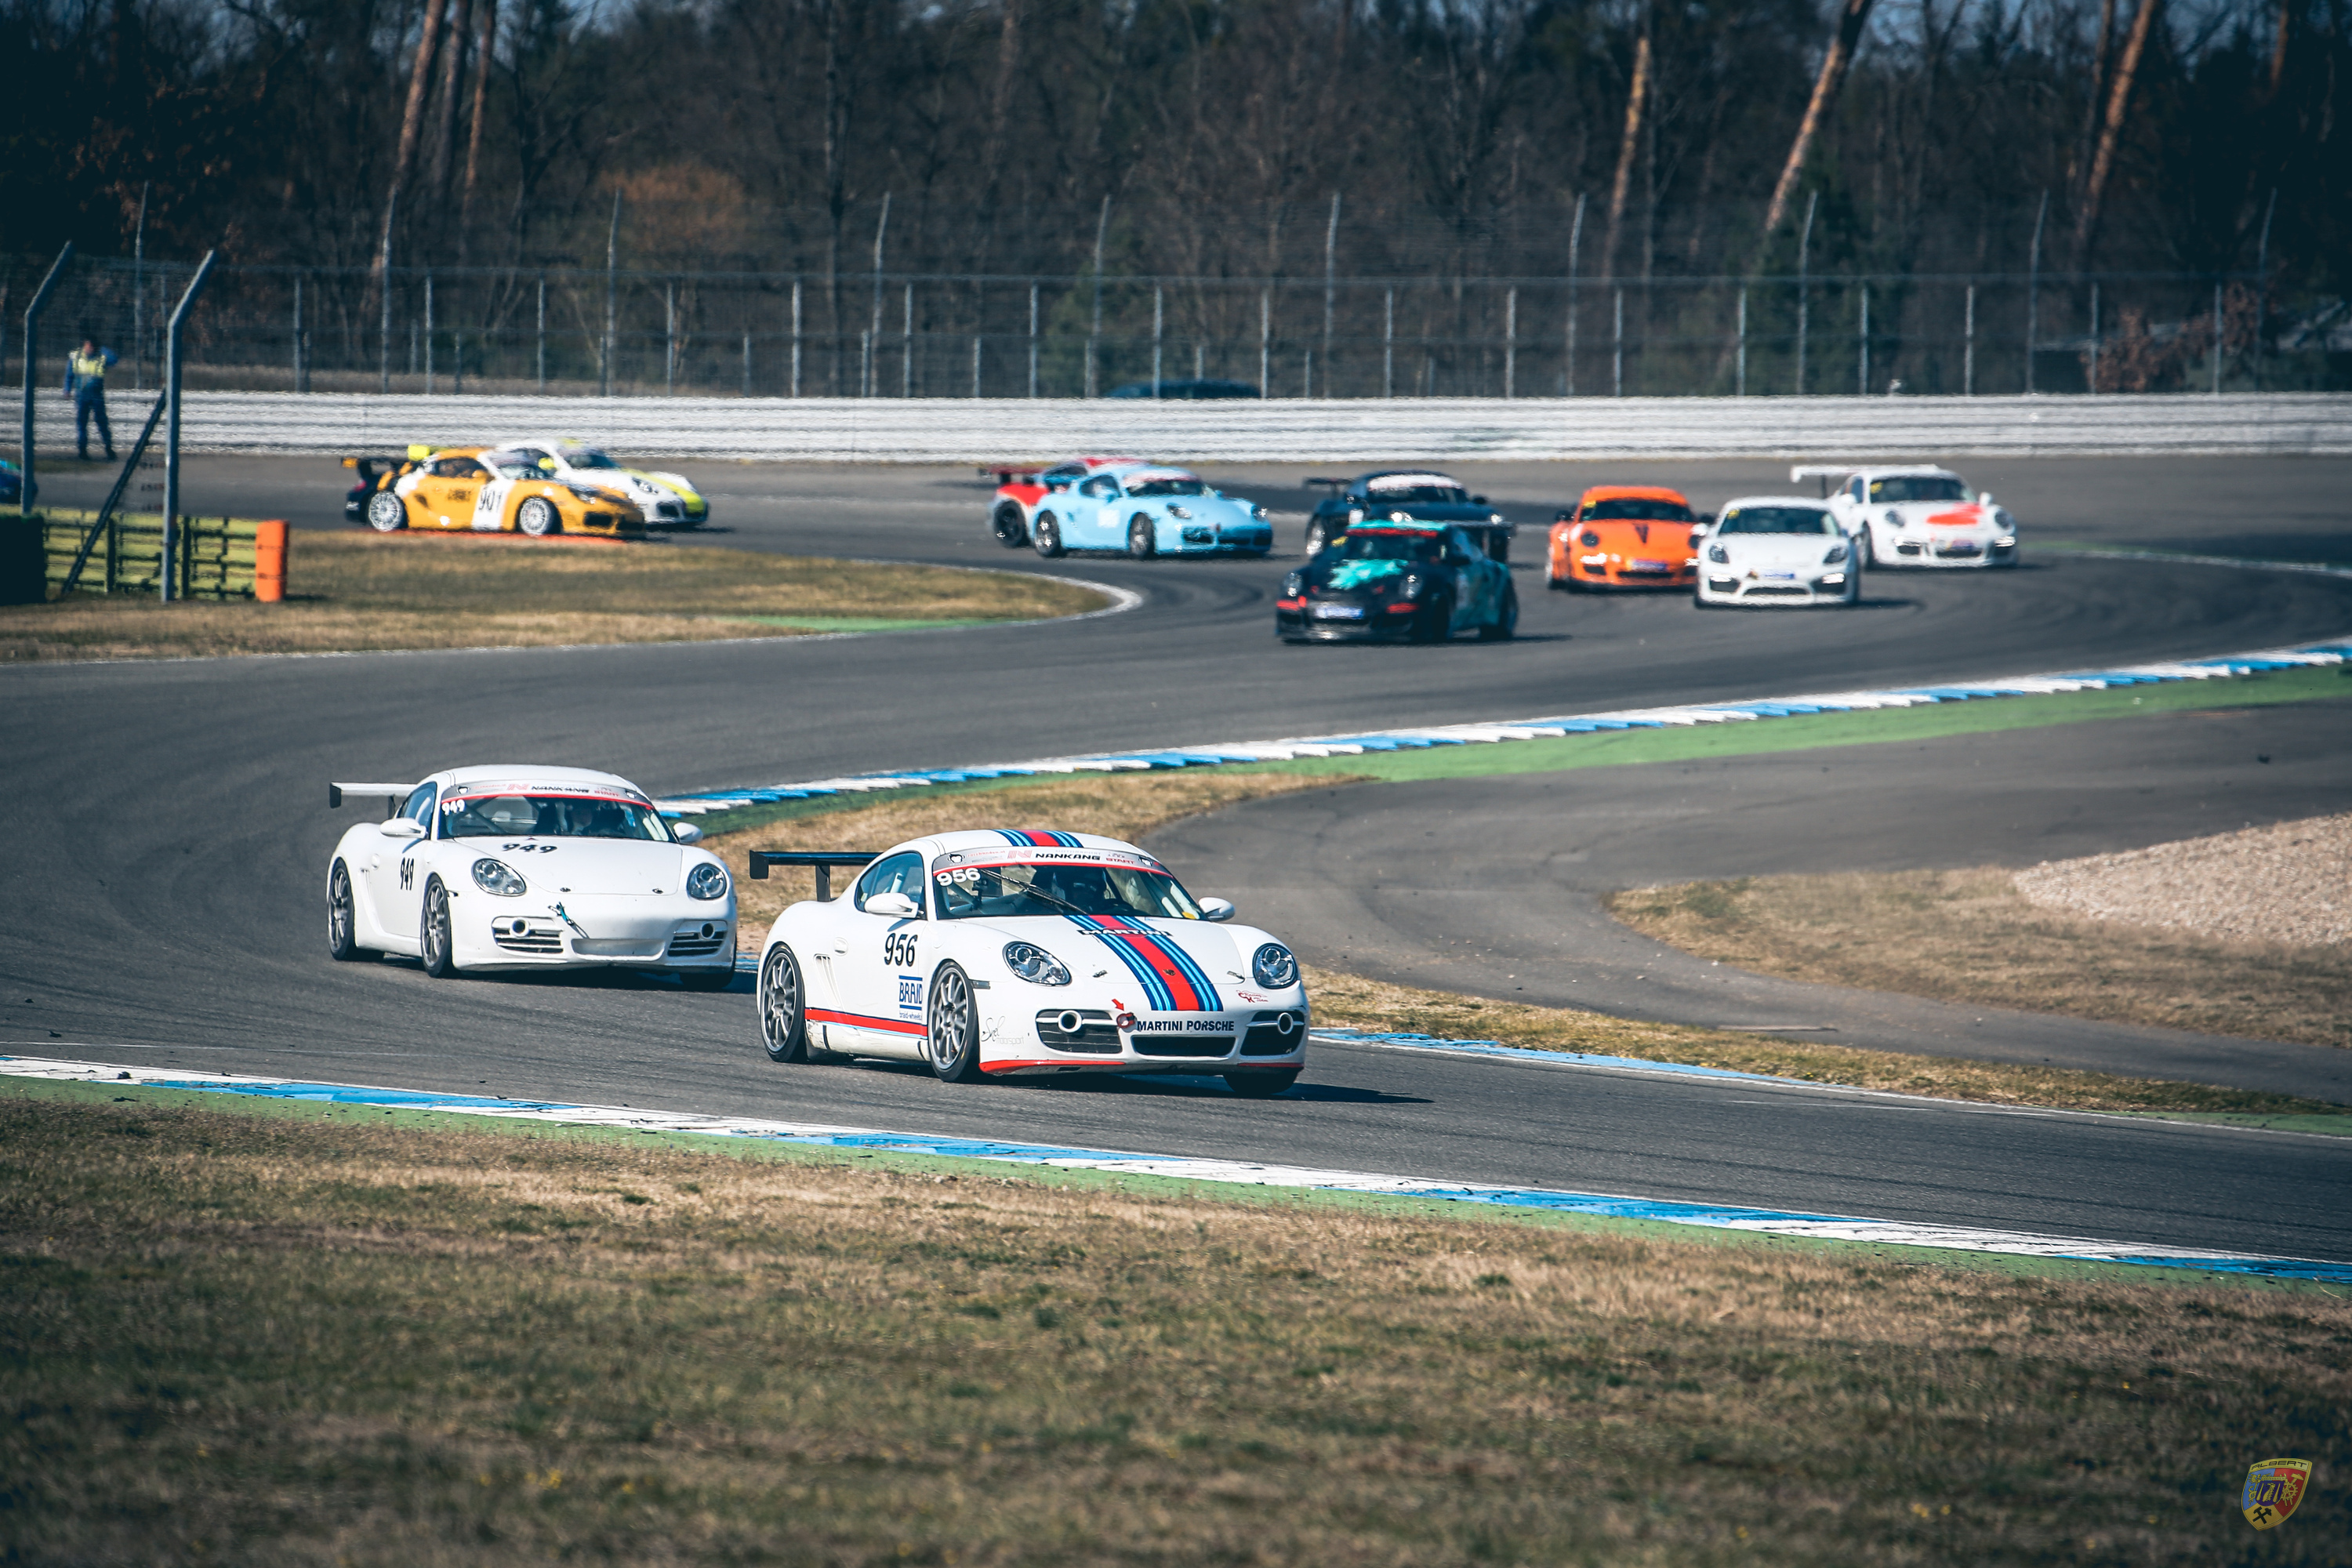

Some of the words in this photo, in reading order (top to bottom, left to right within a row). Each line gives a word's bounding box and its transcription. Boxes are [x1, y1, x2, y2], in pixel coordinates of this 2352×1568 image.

[441, 798, 465, 816] 949
[503, 843, 557, 854] 949
[400, 857, 415, 891] 949
[936, 867, 981, 887] 956
[884, 932, 918, 967] 956
[898, 982, 923, 1004] BRAID
[1137, 1021, 1183, 1031] MARTINI
[1186, 1020, 1235, 1031] PORSCHE
